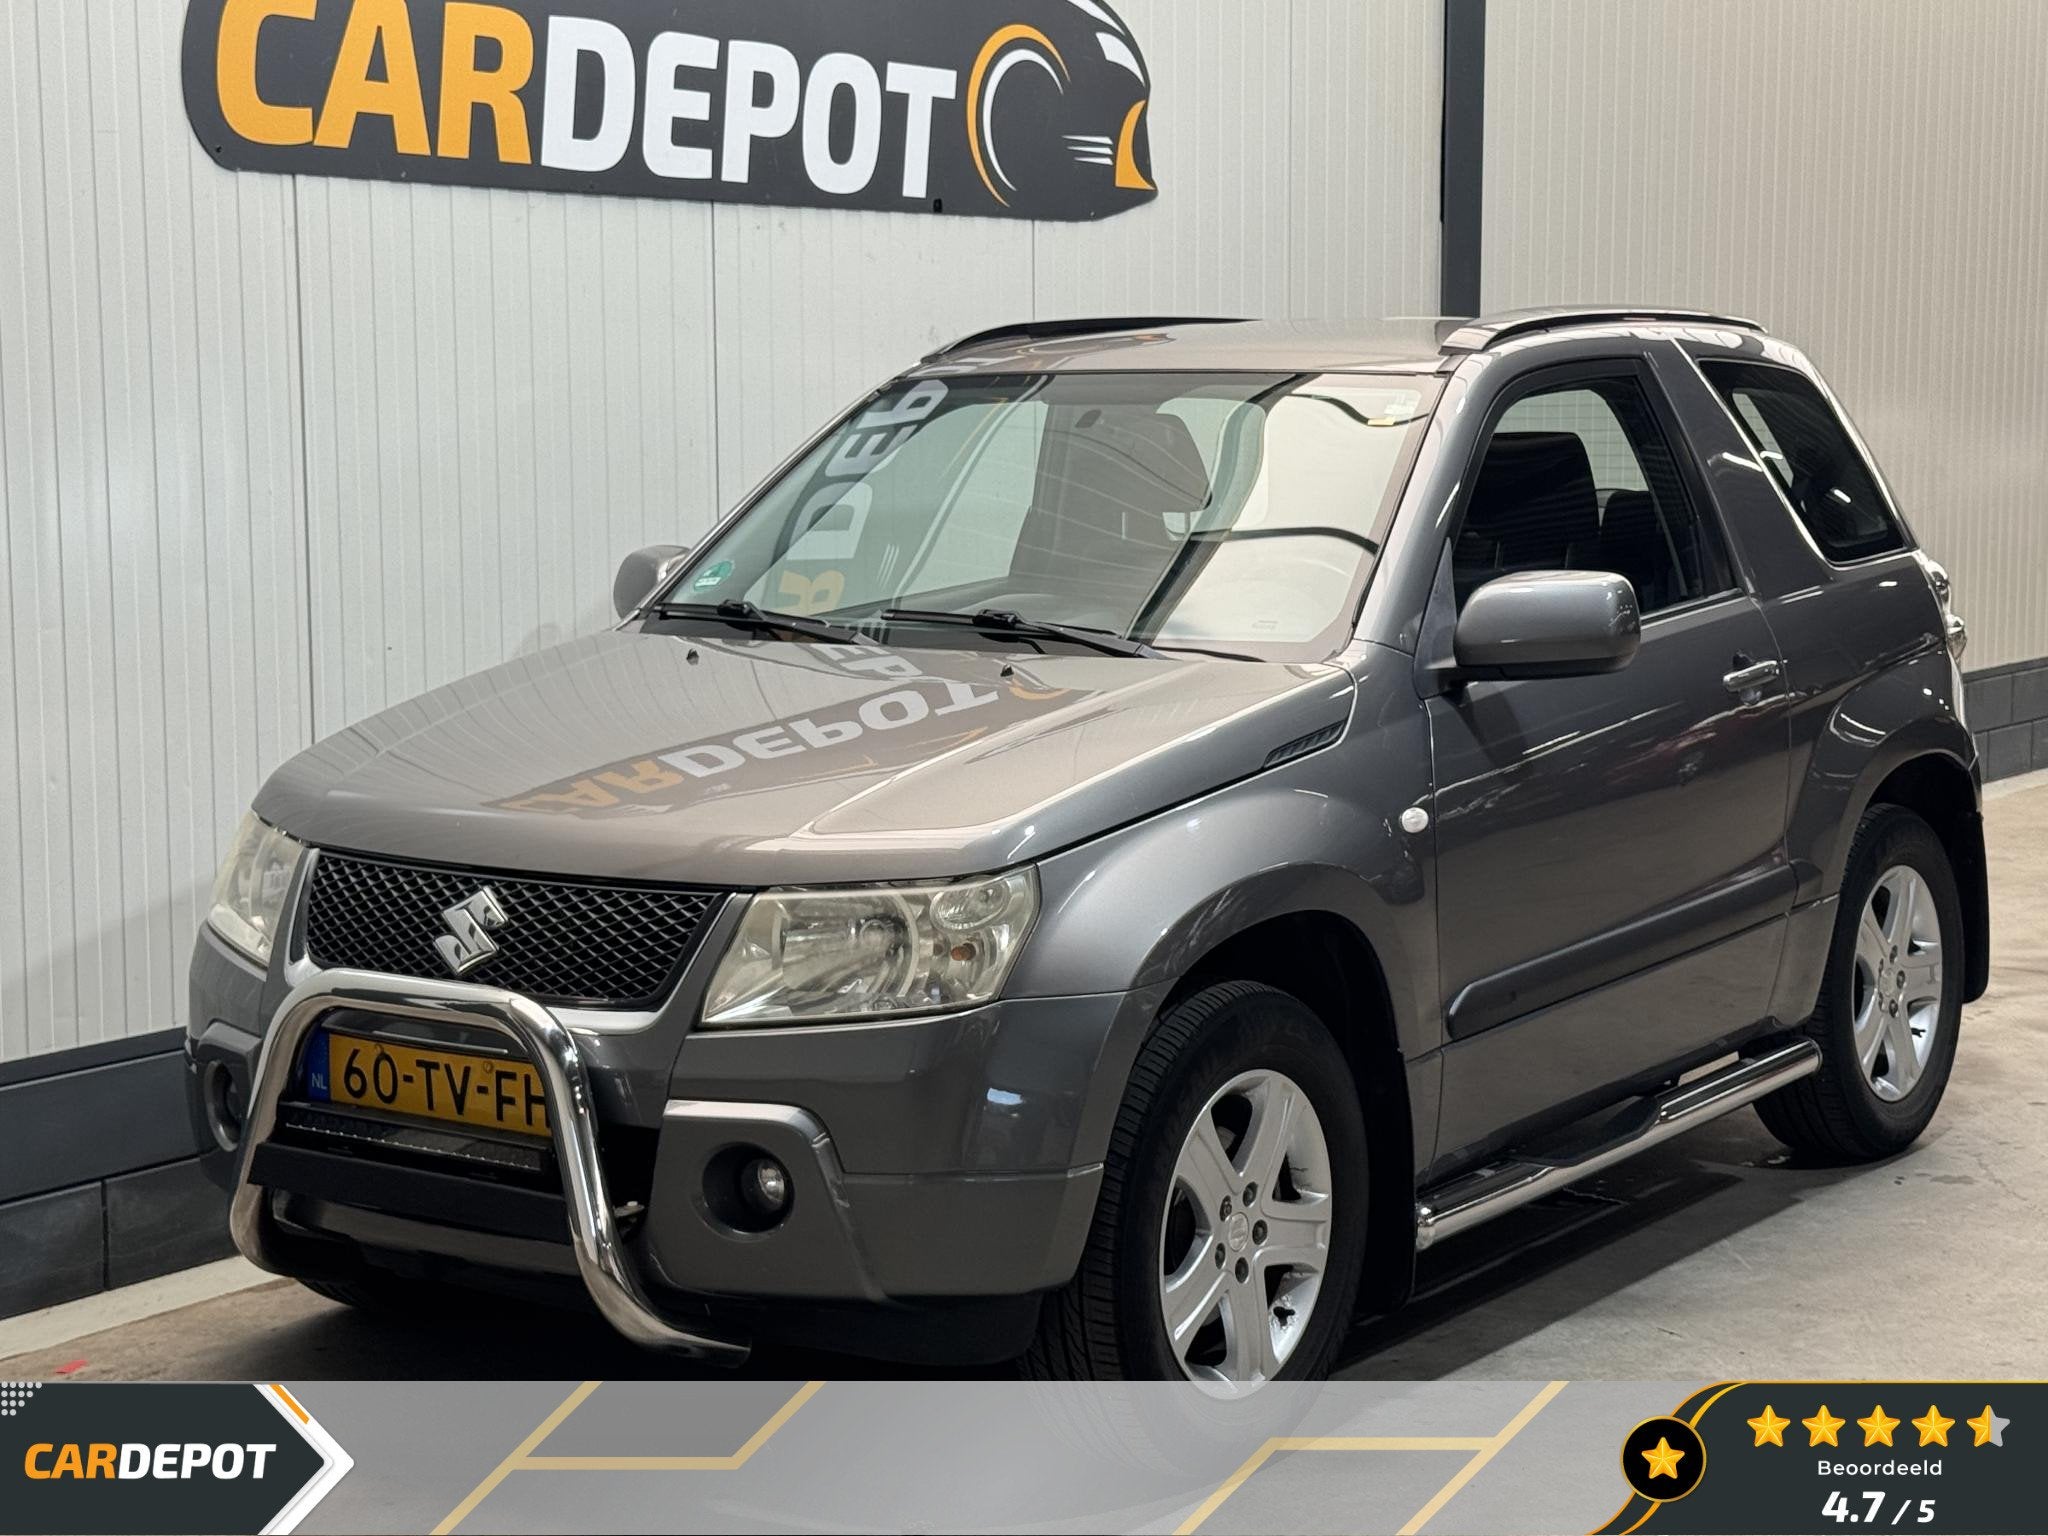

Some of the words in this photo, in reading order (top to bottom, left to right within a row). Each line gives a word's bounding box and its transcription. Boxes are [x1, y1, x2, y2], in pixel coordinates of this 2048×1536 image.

[216, 0, 956, 199] CARDEPOT
[311, 1073, 327, 1091] NL
[343, 1048, 551, 1129] 60-TV-FH
